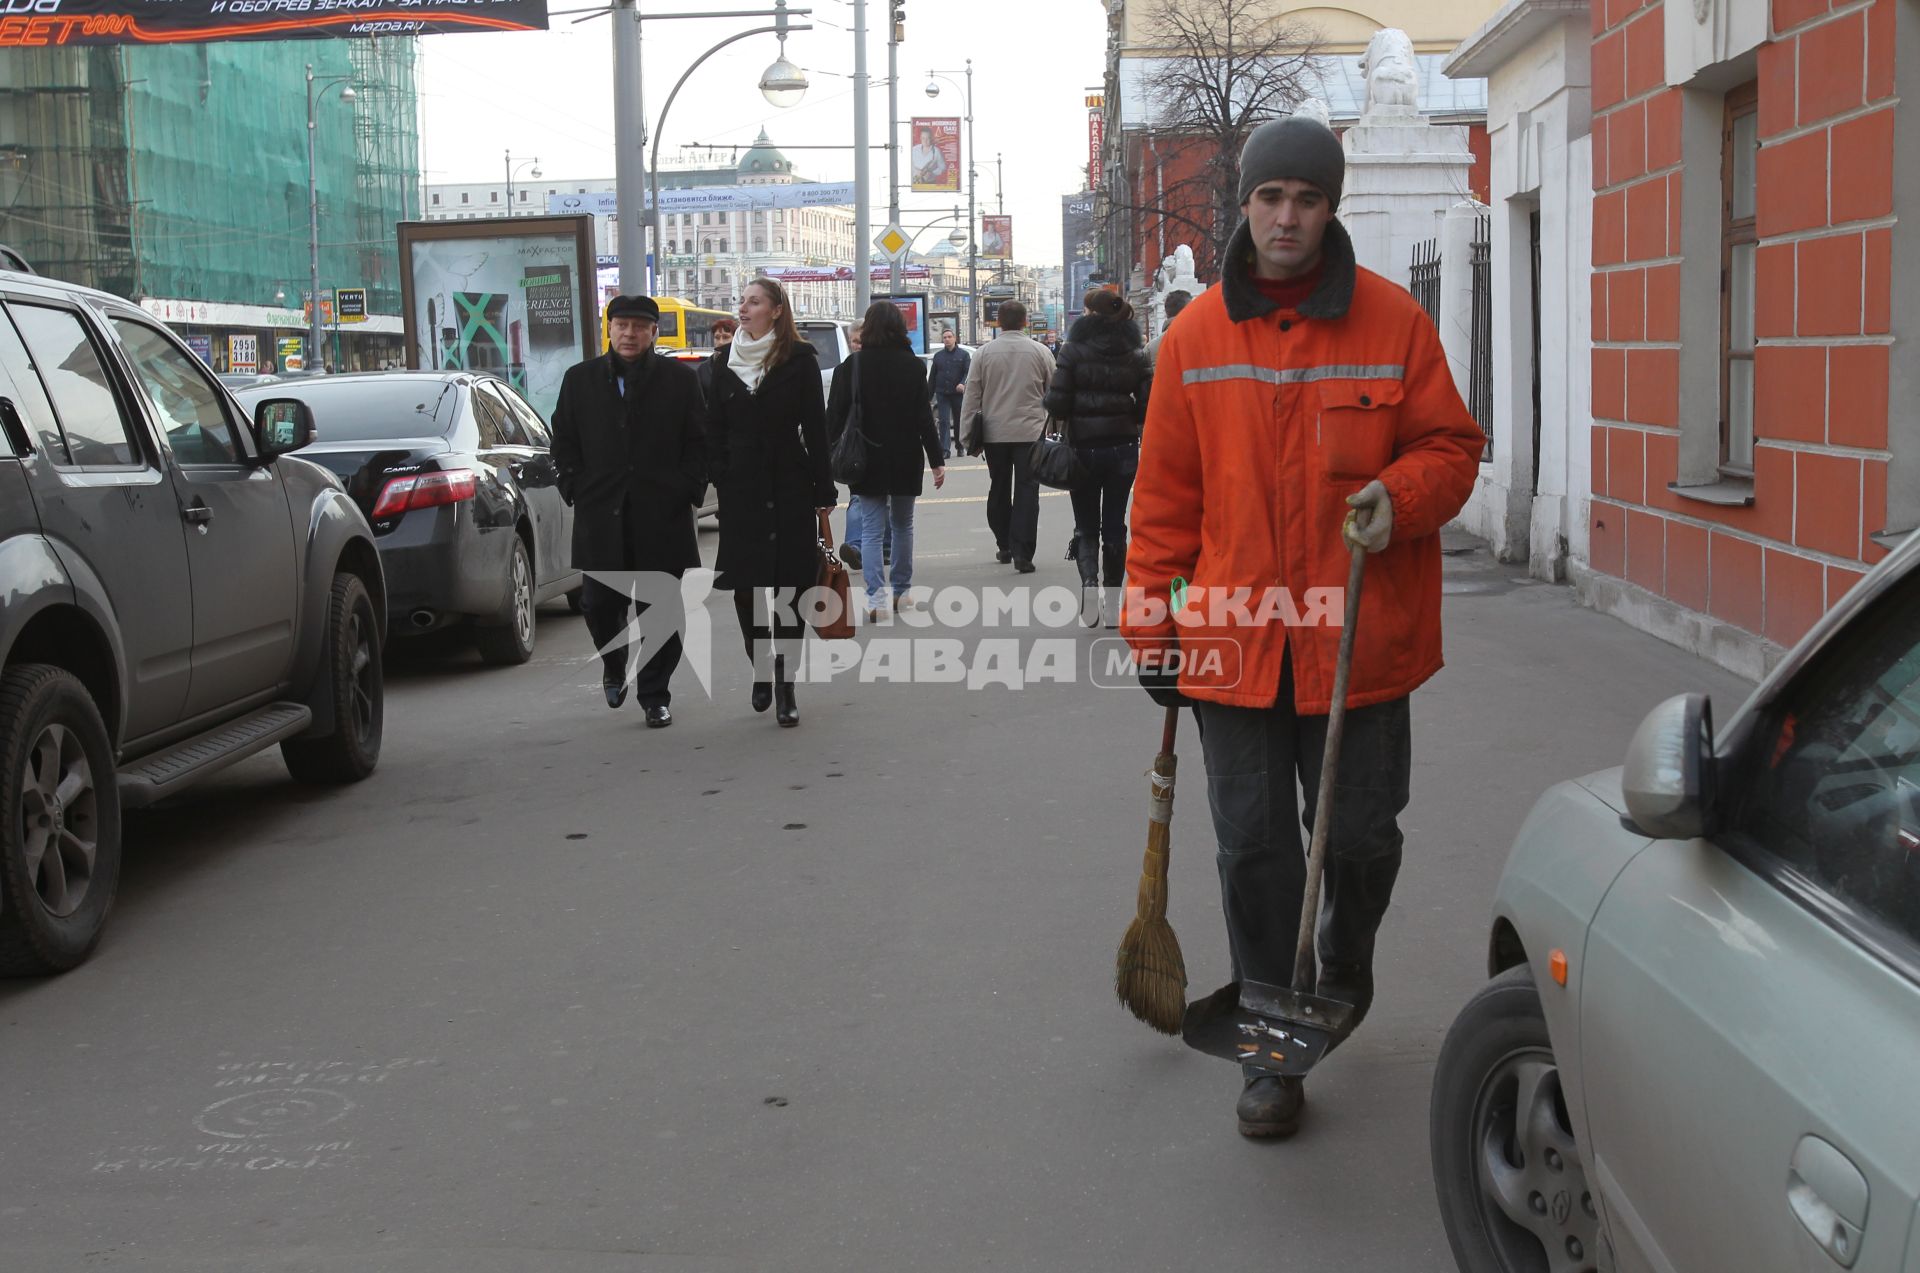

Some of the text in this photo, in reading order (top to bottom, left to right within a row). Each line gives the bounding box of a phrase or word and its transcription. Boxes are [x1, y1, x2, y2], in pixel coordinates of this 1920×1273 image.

[211, 1, 225, 13] И
[229, 0, 310, 13] ОБОГРЕВ
[666, 195, 707, 204] становится
[708, 193, 735, 202] ближе.
[597, 256, 619, 264] OKI
[535, 309, 570, 318] РОСКОШНАЯ
[542, 317, 571, 325] ЛЕГКОСТЬ
[233, 340, 256, 351] 2950
[233, 351, 256, 362] 3180
